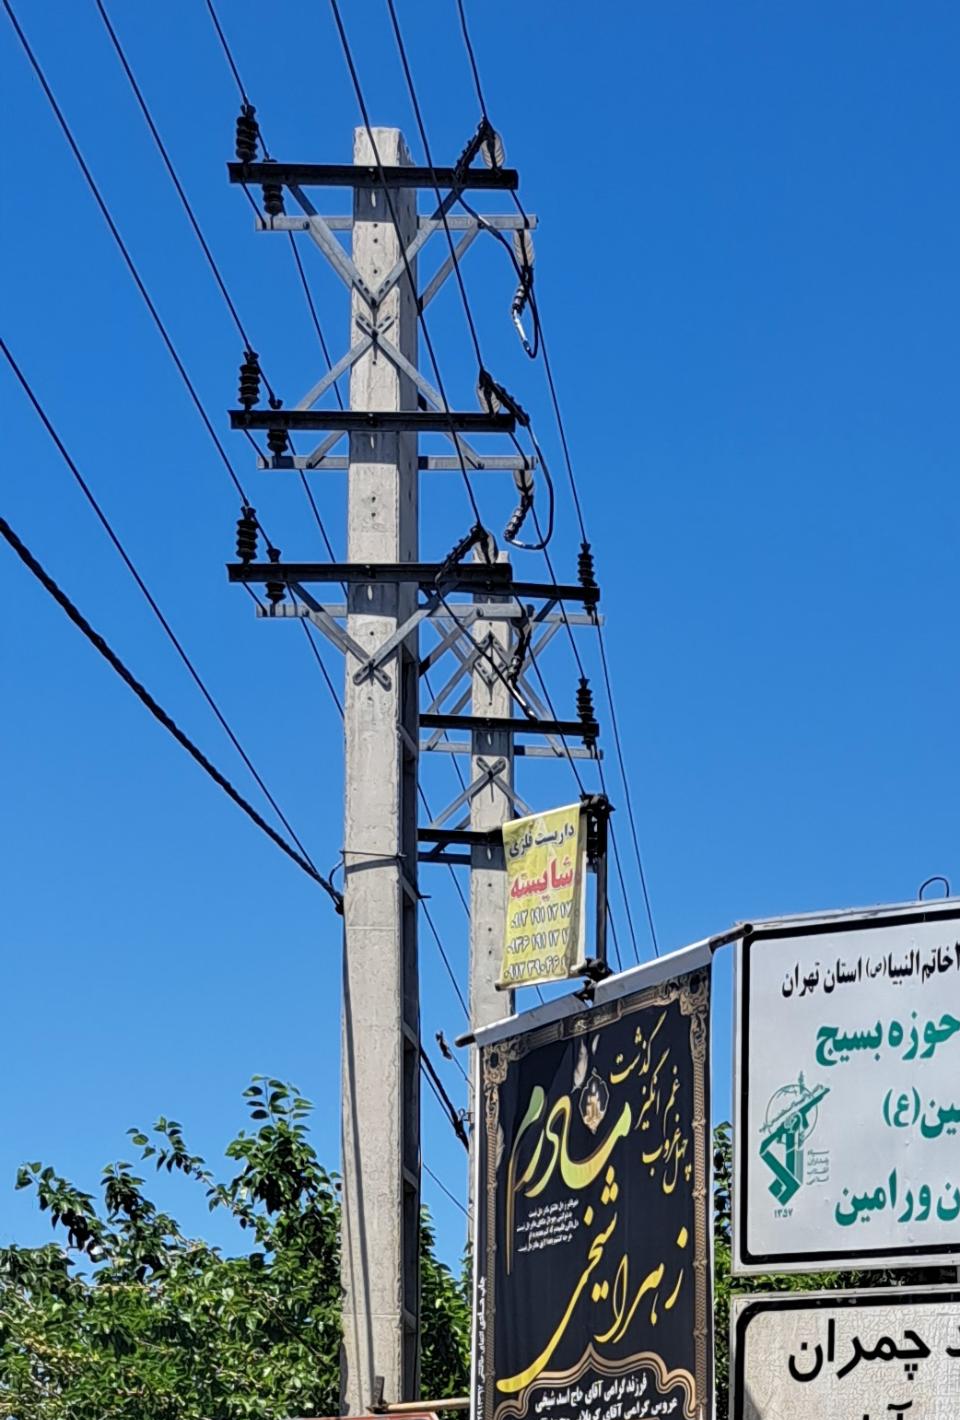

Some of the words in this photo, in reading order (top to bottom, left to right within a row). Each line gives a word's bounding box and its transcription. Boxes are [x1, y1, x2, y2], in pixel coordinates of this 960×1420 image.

[509, 830, 534, 858] فلزی
[534, 822, 575, 847] داربست
[510, 856, 574, 901] شایسته
[781, 964, 821, 998] تهران
[822, 956, 862, 996] استان
[815, 1019, 883, 1067] بسیج
[882, 1086, 920, 1129] (ع)
[834, 1168, 931, 1227] ورامین
[787, 1318, 931, 1384] چمران
